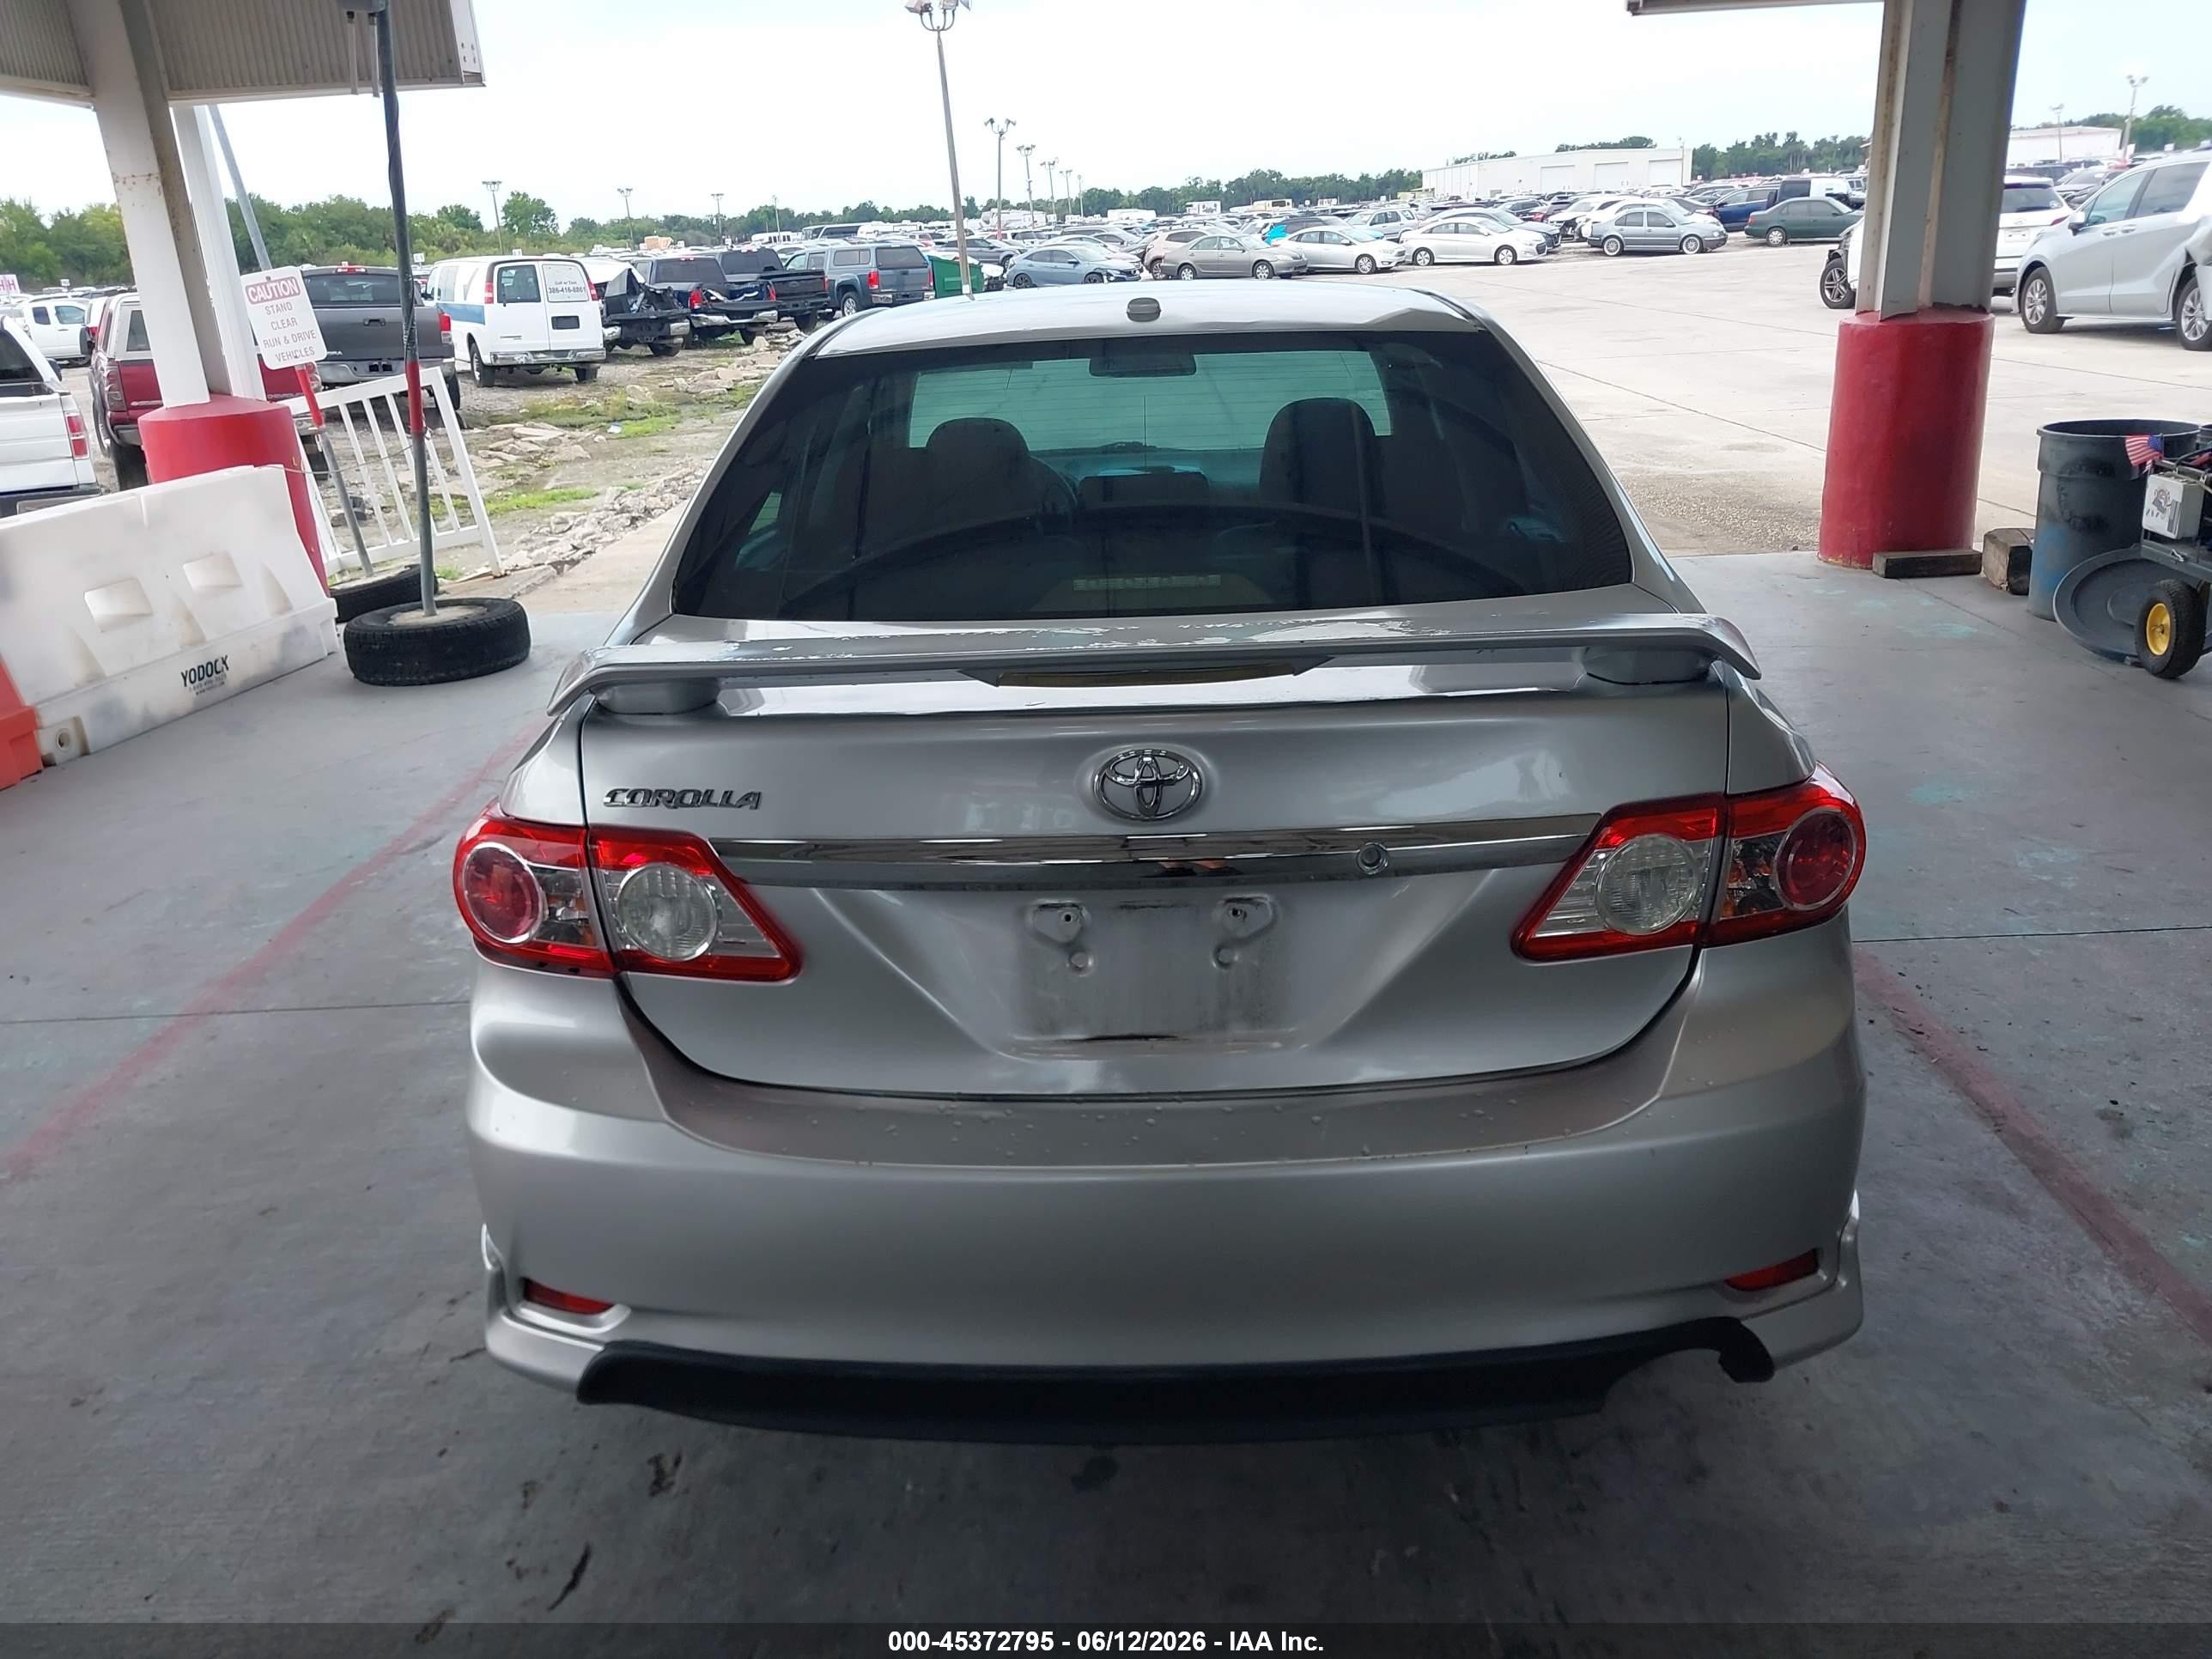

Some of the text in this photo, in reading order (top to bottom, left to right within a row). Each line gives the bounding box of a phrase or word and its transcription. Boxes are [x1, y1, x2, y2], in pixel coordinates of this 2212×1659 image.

[247, 278, 300, 303] CAUTION
[264, 301, 293, 316] STAND
[270, 317, 298, 331] CLEAR
[263, 330, 317, 349] RUN & DRIVE
[275, 346, 316, 362] VEHICLES
[180, 654, 229, 688] YODOCK
[603, 787, 763, 811] COROLLA
